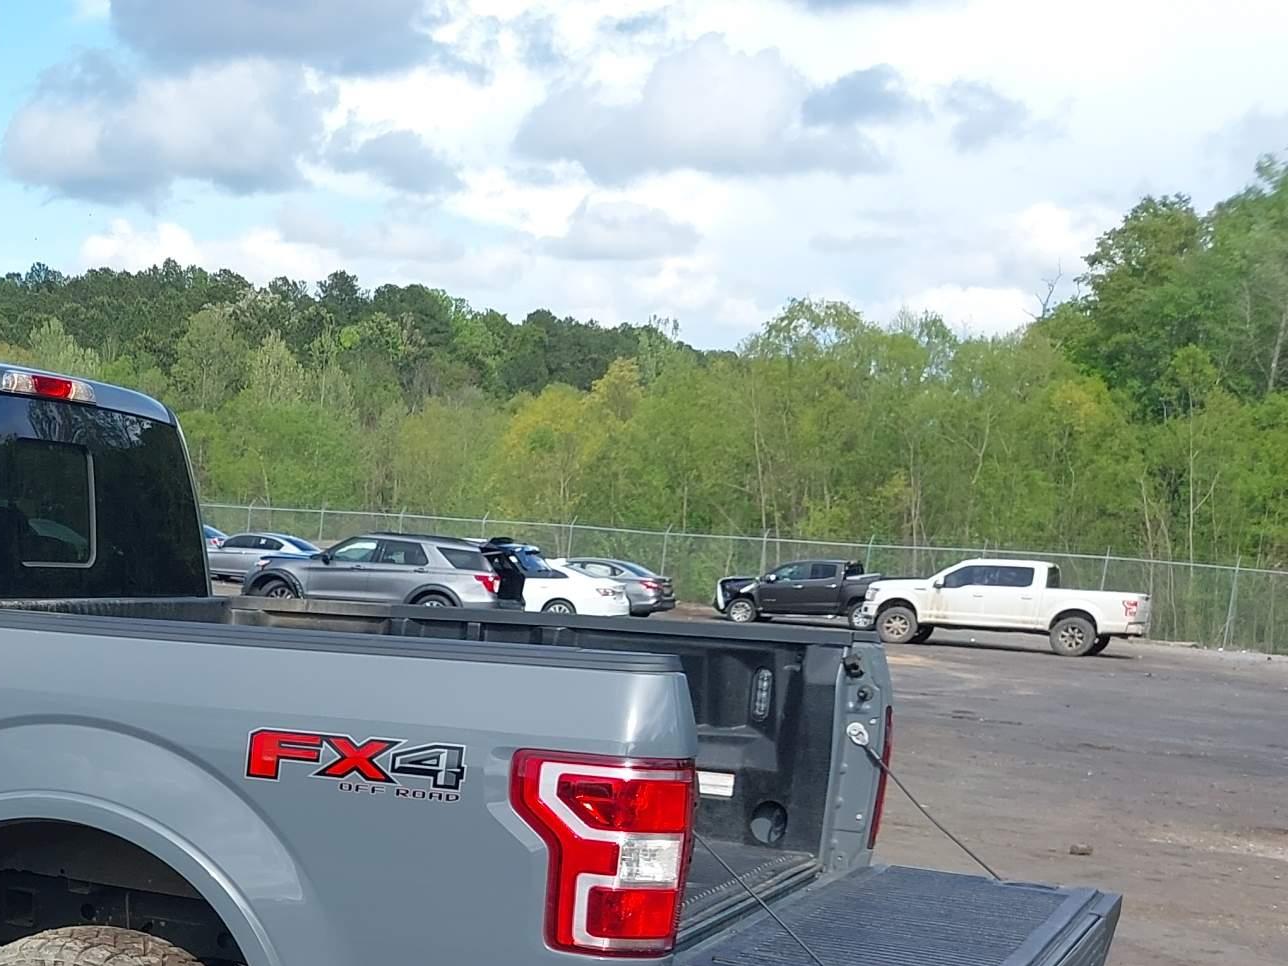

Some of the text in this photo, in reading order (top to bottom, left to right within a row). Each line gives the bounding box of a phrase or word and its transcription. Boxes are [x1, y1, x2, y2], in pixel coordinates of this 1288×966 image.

[245, 727, 468, 791] FX4
[339, 782, 460, 803] OFF ROAD
